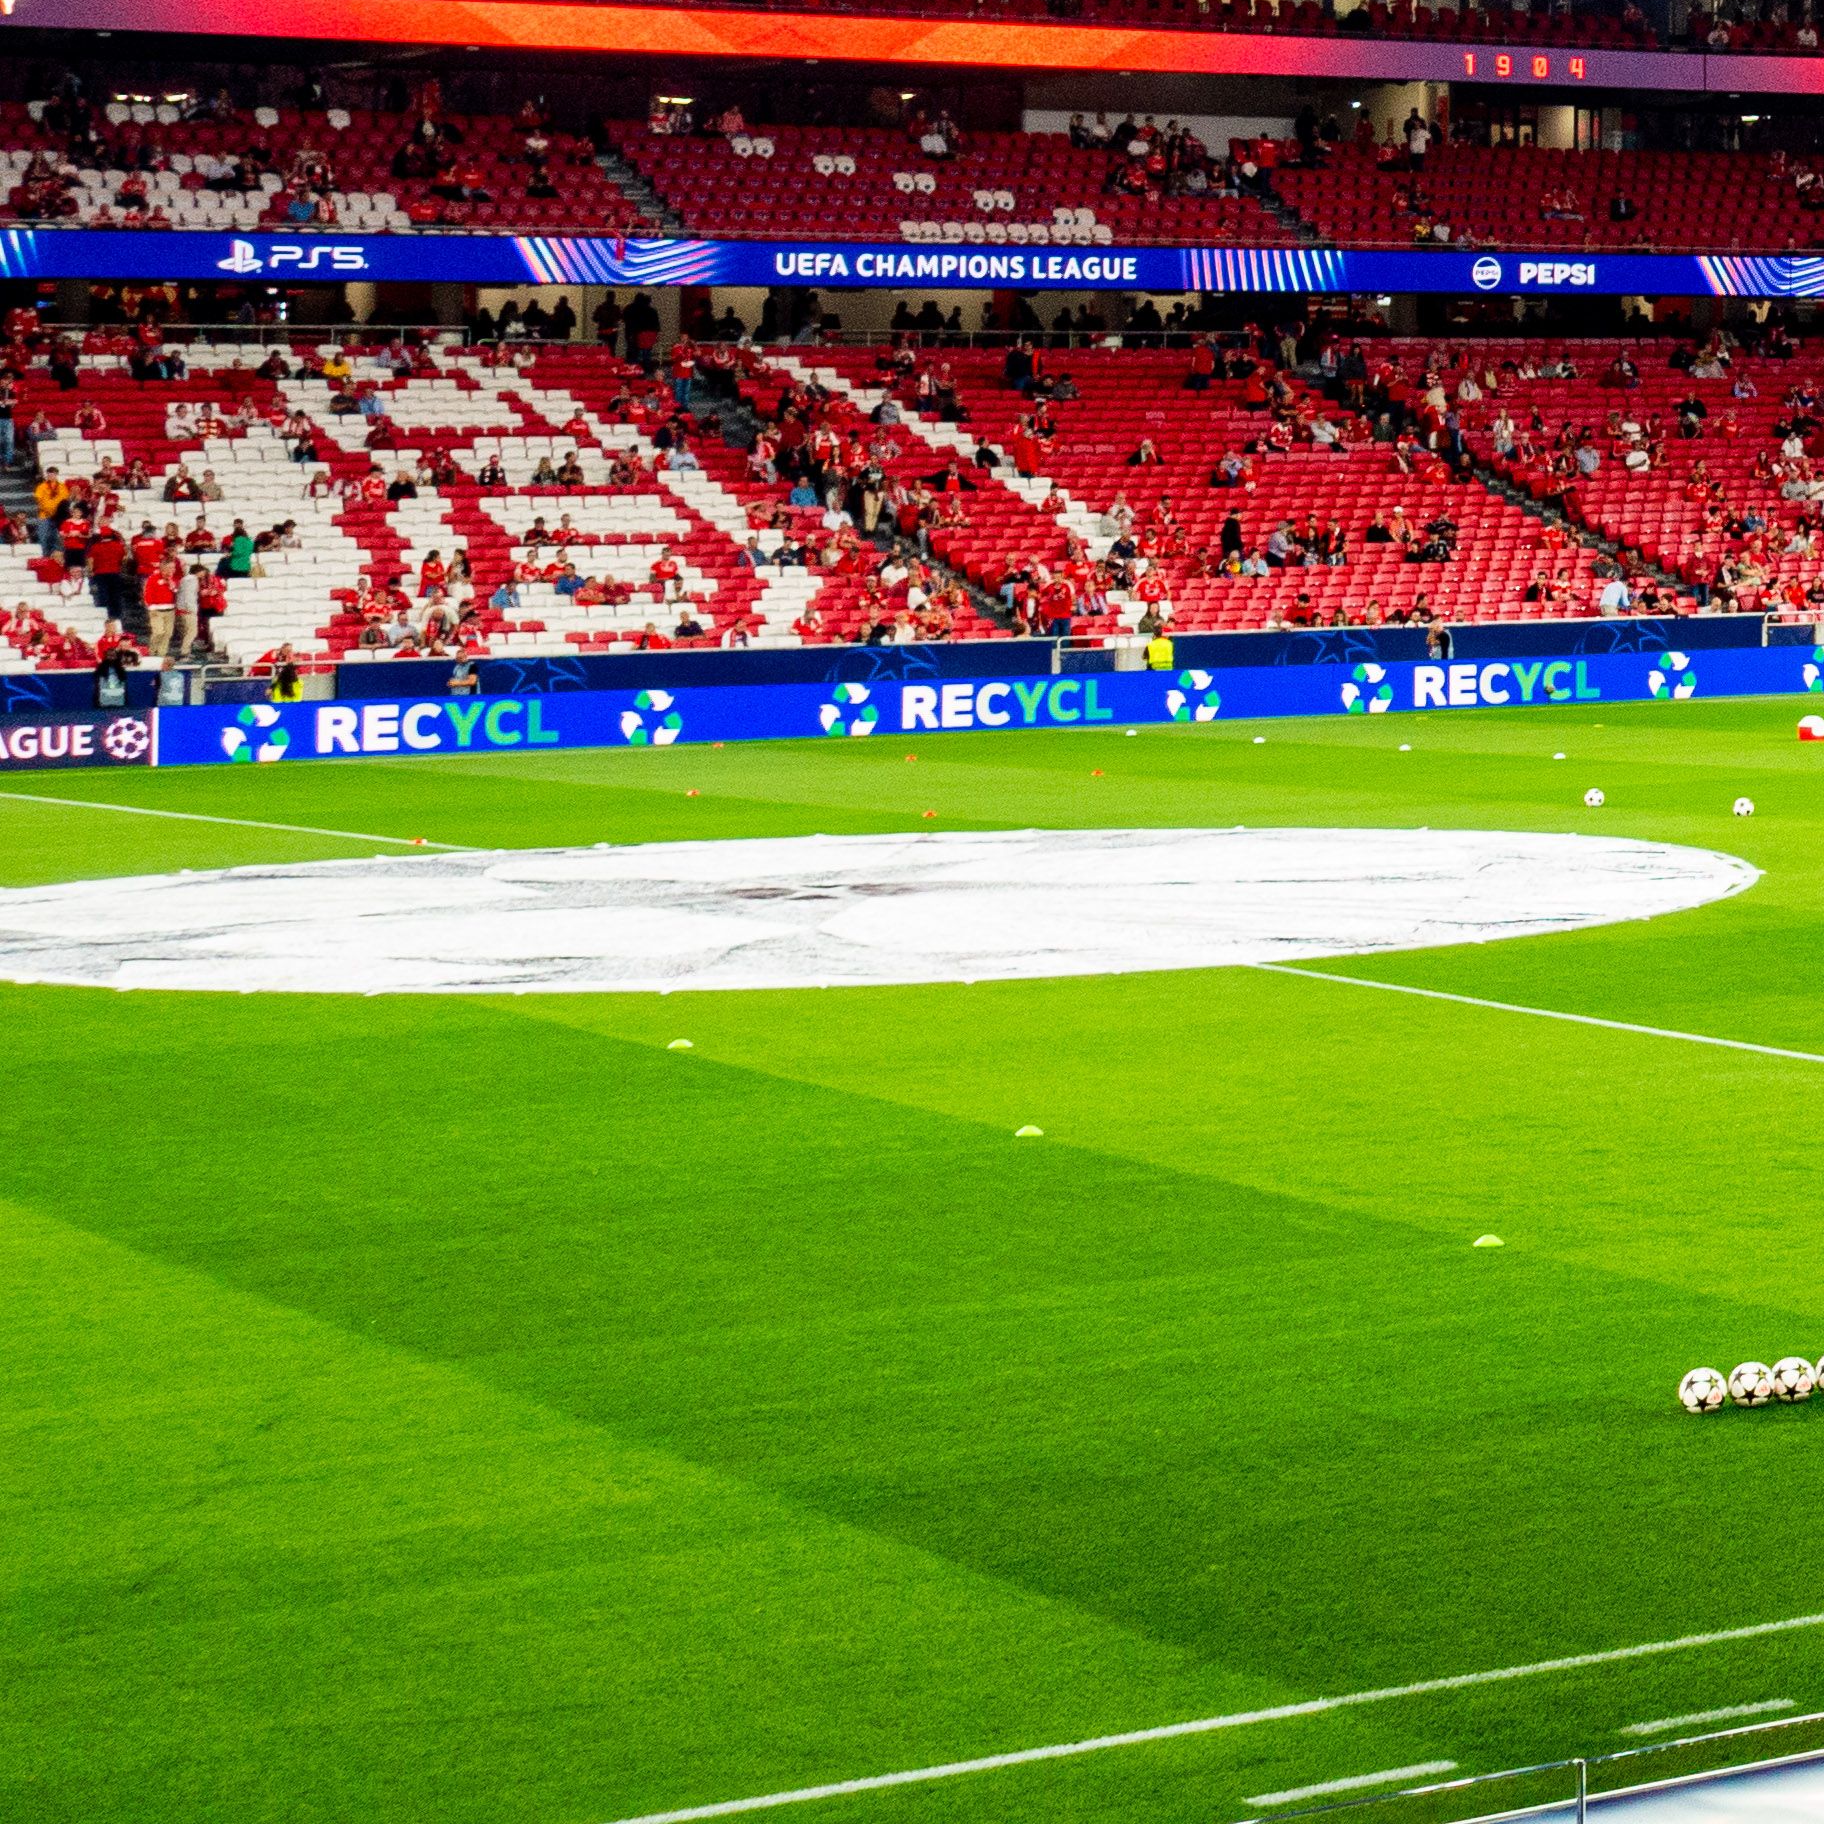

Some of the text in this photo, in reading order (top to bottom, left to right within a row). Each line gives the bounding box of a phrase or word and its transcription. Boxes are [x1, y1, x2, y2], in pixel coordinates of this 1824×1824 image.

[1463, 52, 1586, 79] 1904
[269, 245, 367, 269] PS5
[775, 252, 1137, 280] UEFA CHAMPIONS LEAGUE
[1519, 262, 1595, 286] PEPSI
[1412, 659, 1600, 707] RECYCL
[901, 678, 1112, 730] RECYCL
[316, 701, 559, 754] RECYCL
